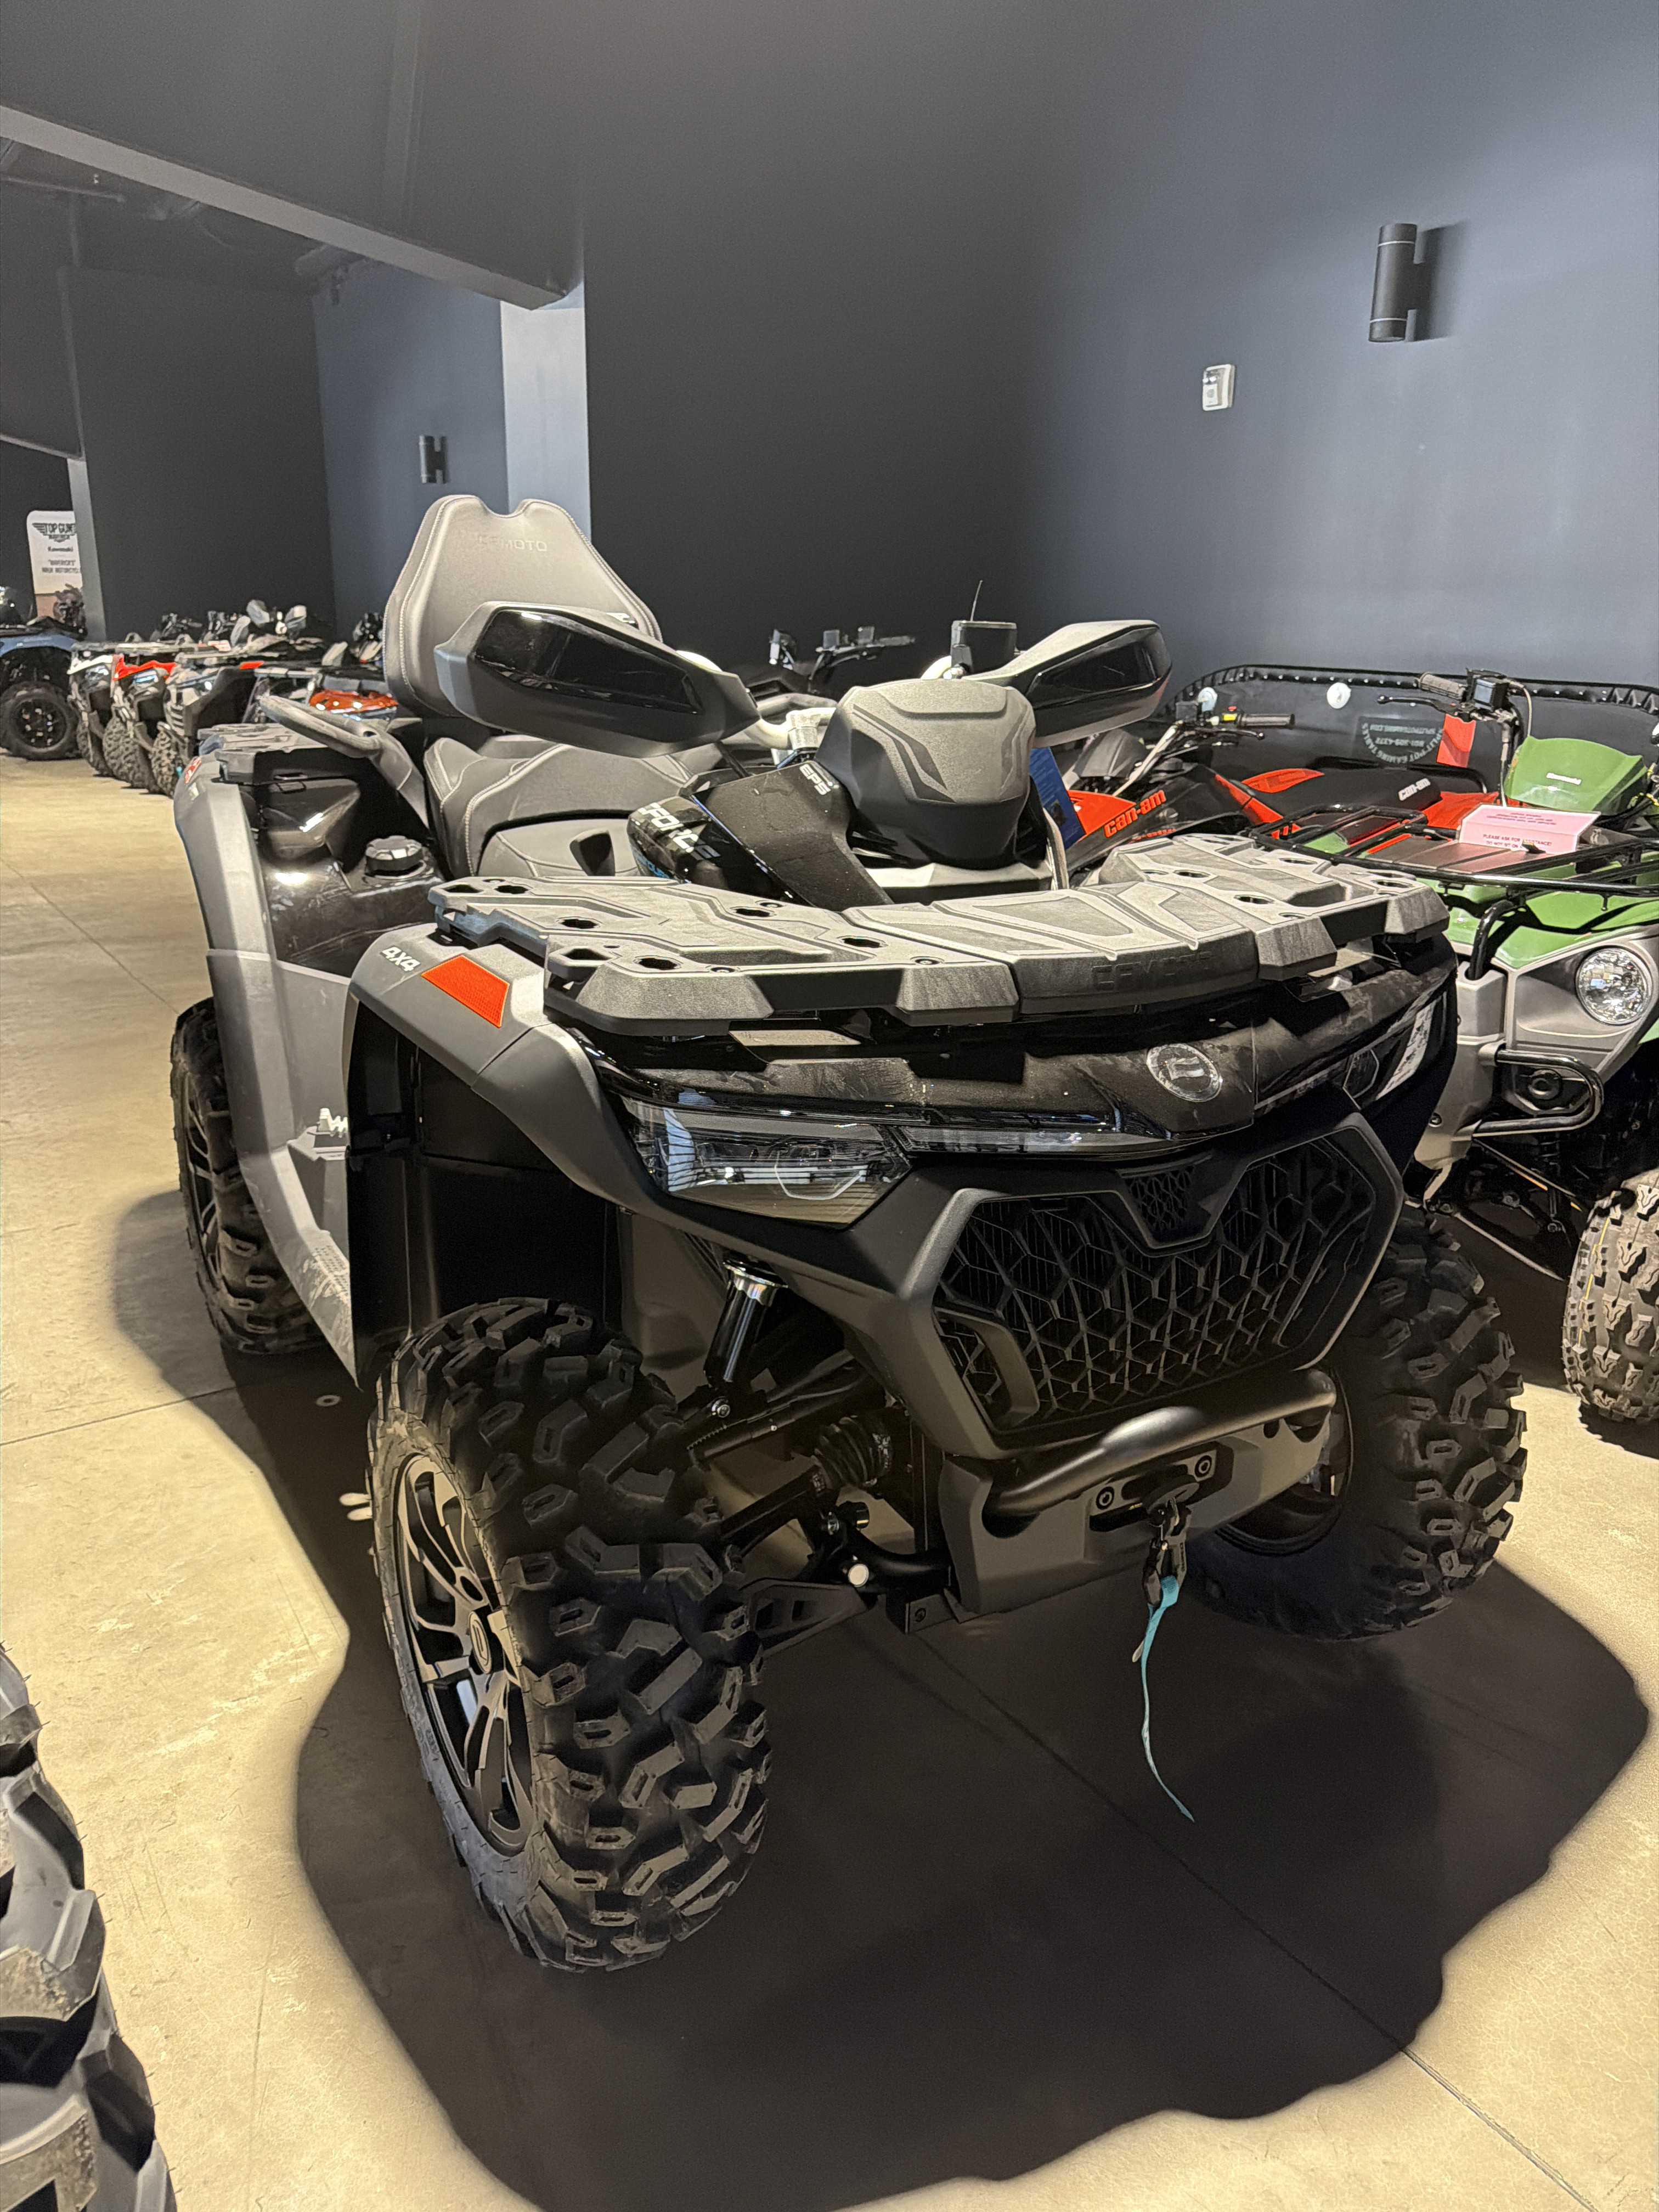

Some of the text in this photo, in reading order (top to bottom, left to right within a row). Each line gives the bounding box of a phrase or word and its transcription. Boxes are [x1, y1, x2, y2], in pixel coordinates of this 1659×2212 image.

[799, 764, 832, 795] EPS
[1103, 789, 1166, 838] can-am
[381, 946, 421, 972] 4X4
